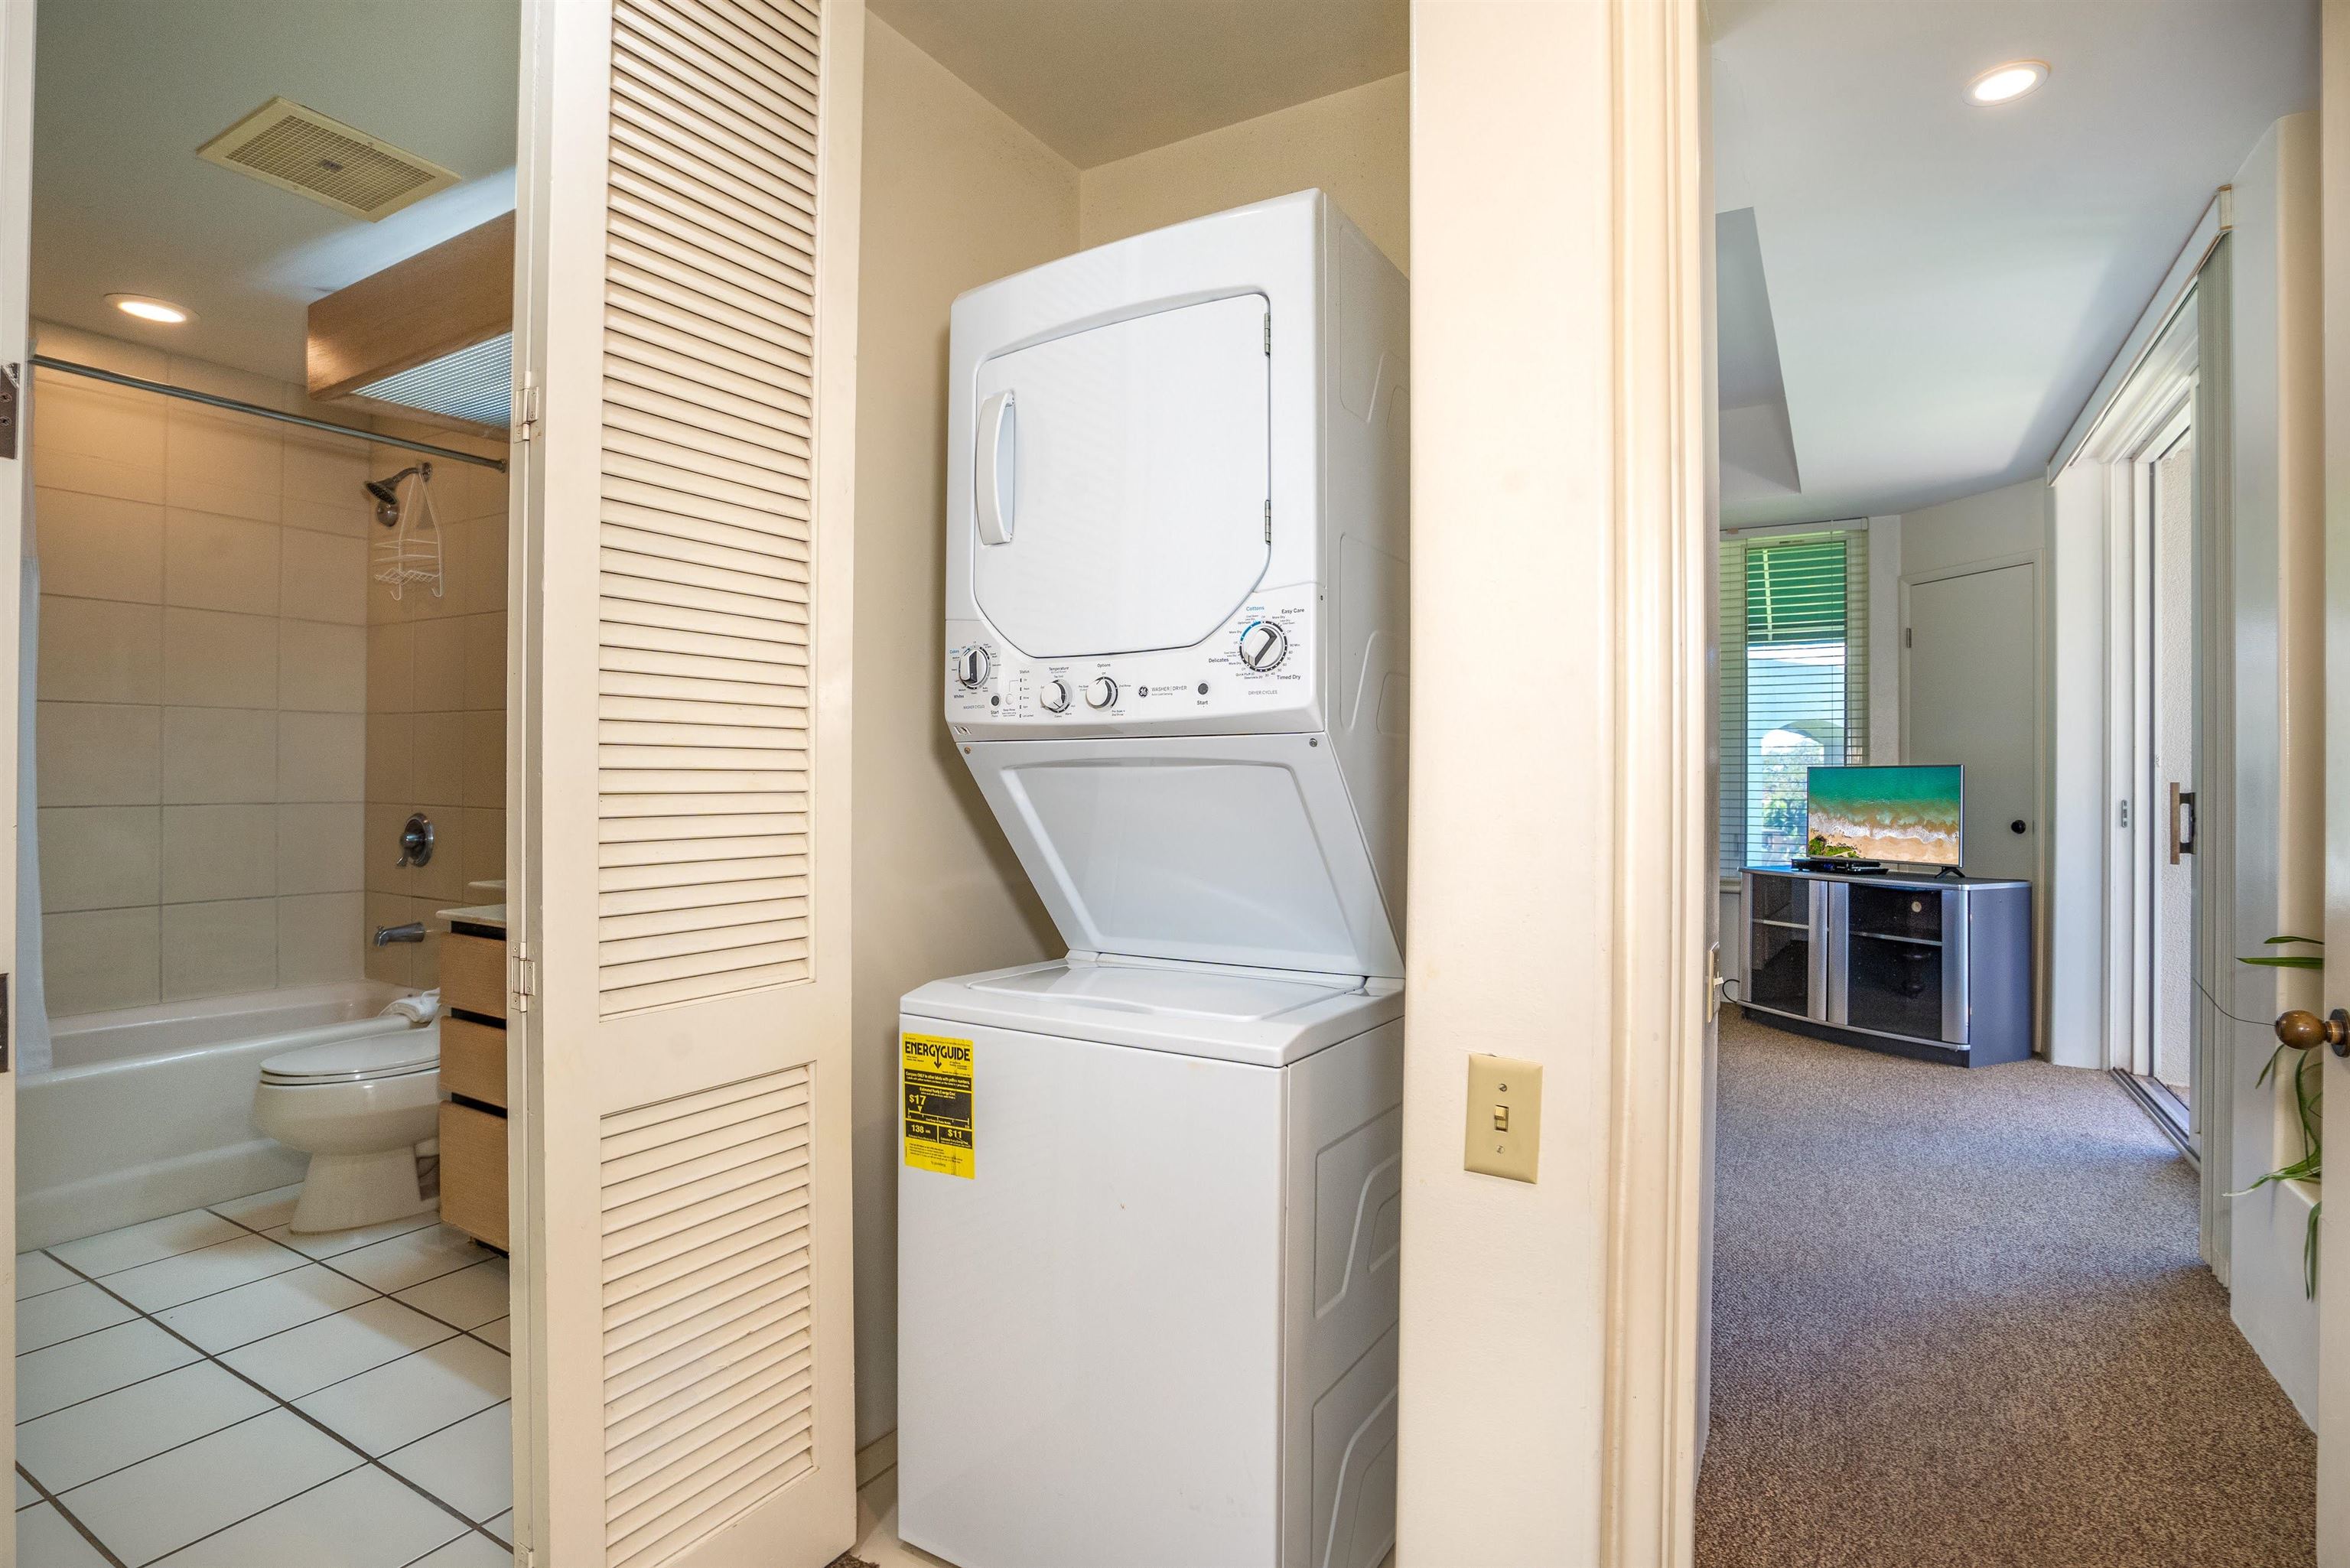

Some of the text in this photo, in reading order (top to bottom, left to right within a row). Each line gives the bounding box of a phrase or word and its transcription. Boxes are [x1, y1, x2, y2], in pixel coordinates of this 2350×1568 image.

[905, 1041, 970, 1062] ENERGYGUIDE
[909, 1094, 926, 1105] $17
[912, 1124, 924, 1133] 138
[948, 1129, 962, 1138] $11
